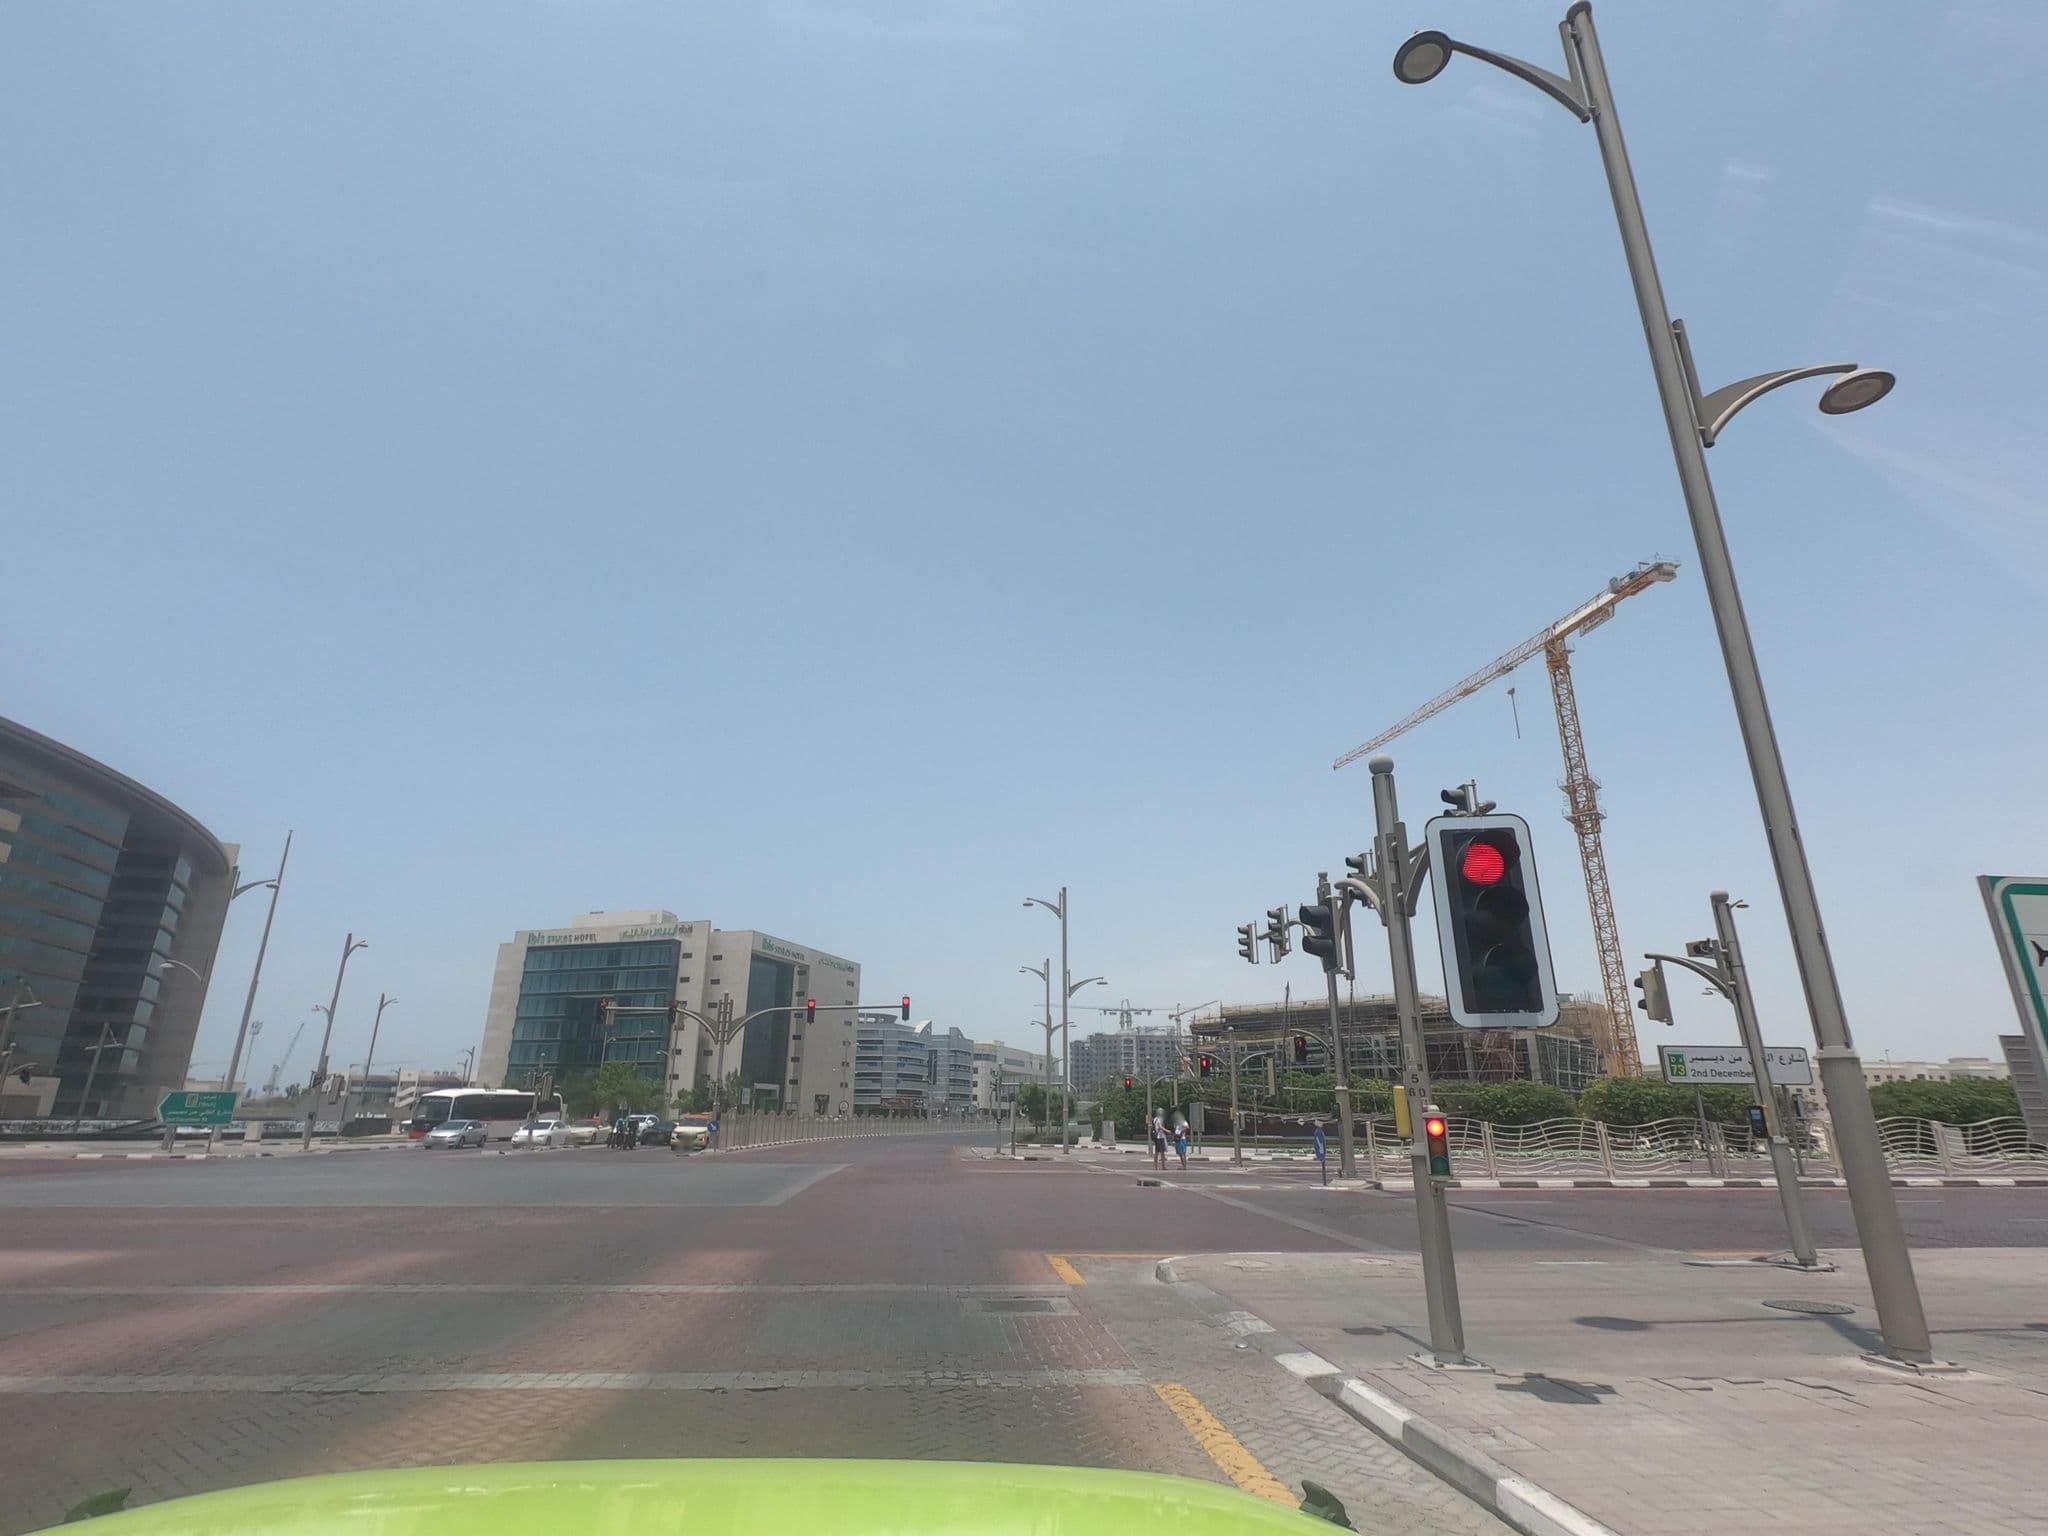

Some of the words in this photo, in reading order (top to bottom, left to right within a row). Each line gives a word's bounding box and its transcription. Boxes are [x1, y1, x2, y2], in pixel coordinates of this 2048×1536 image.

[1728, 1055, 1743, 1065] من
[1670, 1065, 1686, 1076] 73
[1690, 1069, 1708, 1078] 2nd
[1411, 1074, 1419, 1083] 5
